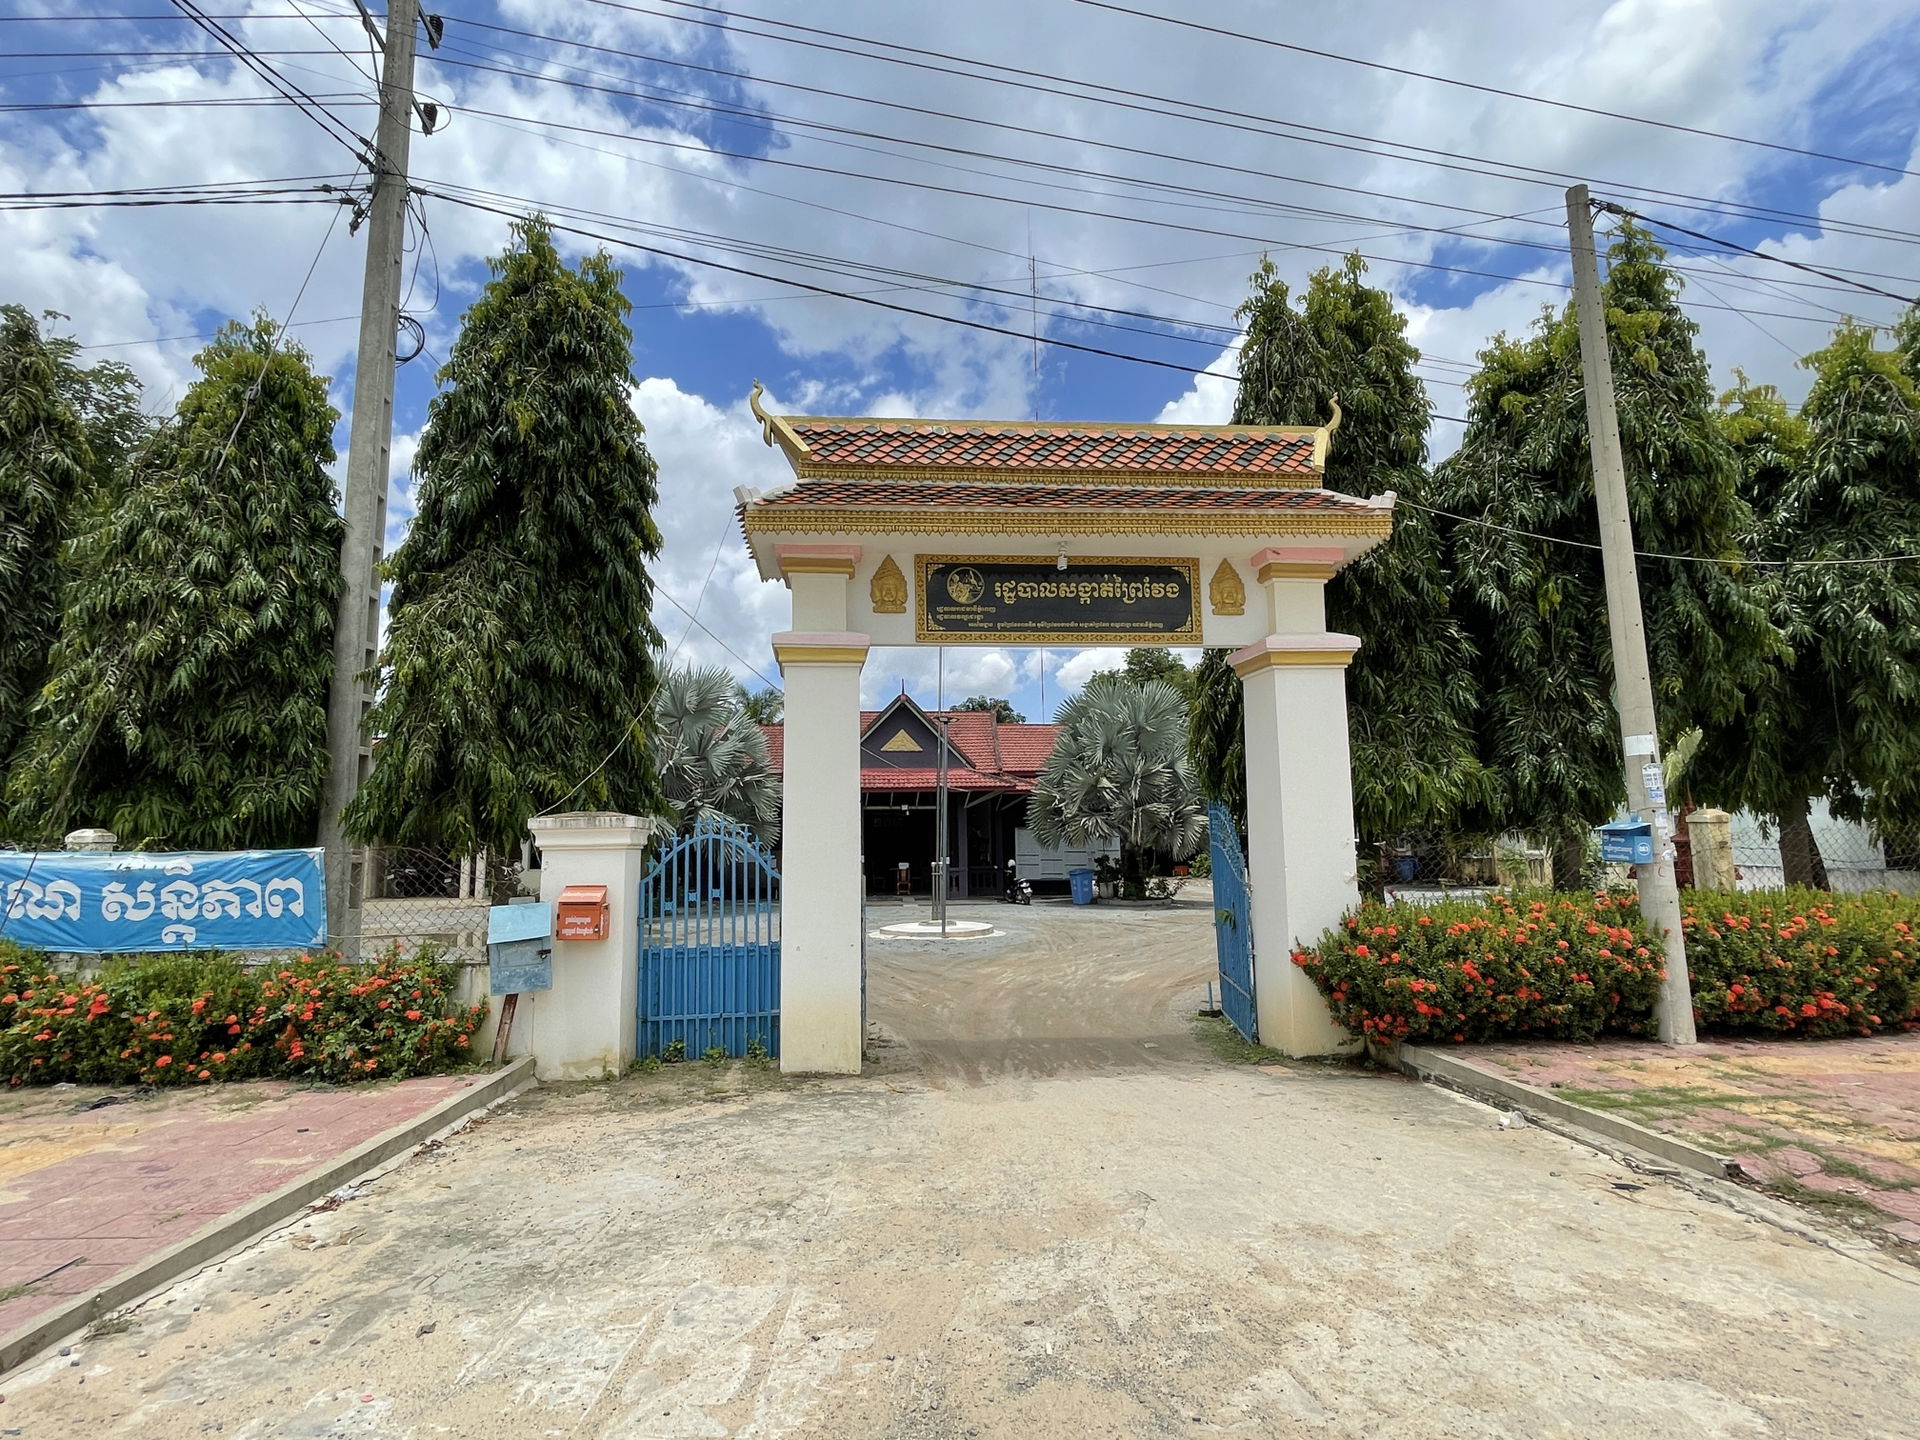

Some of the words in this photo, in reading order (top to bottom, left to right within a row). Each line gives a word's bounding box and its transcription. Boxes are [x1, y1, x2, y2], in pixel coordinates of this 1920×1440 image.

[994, 574, 1180, 605] រដ្ឋបាលសង្កាត់ព្រៃវែង
